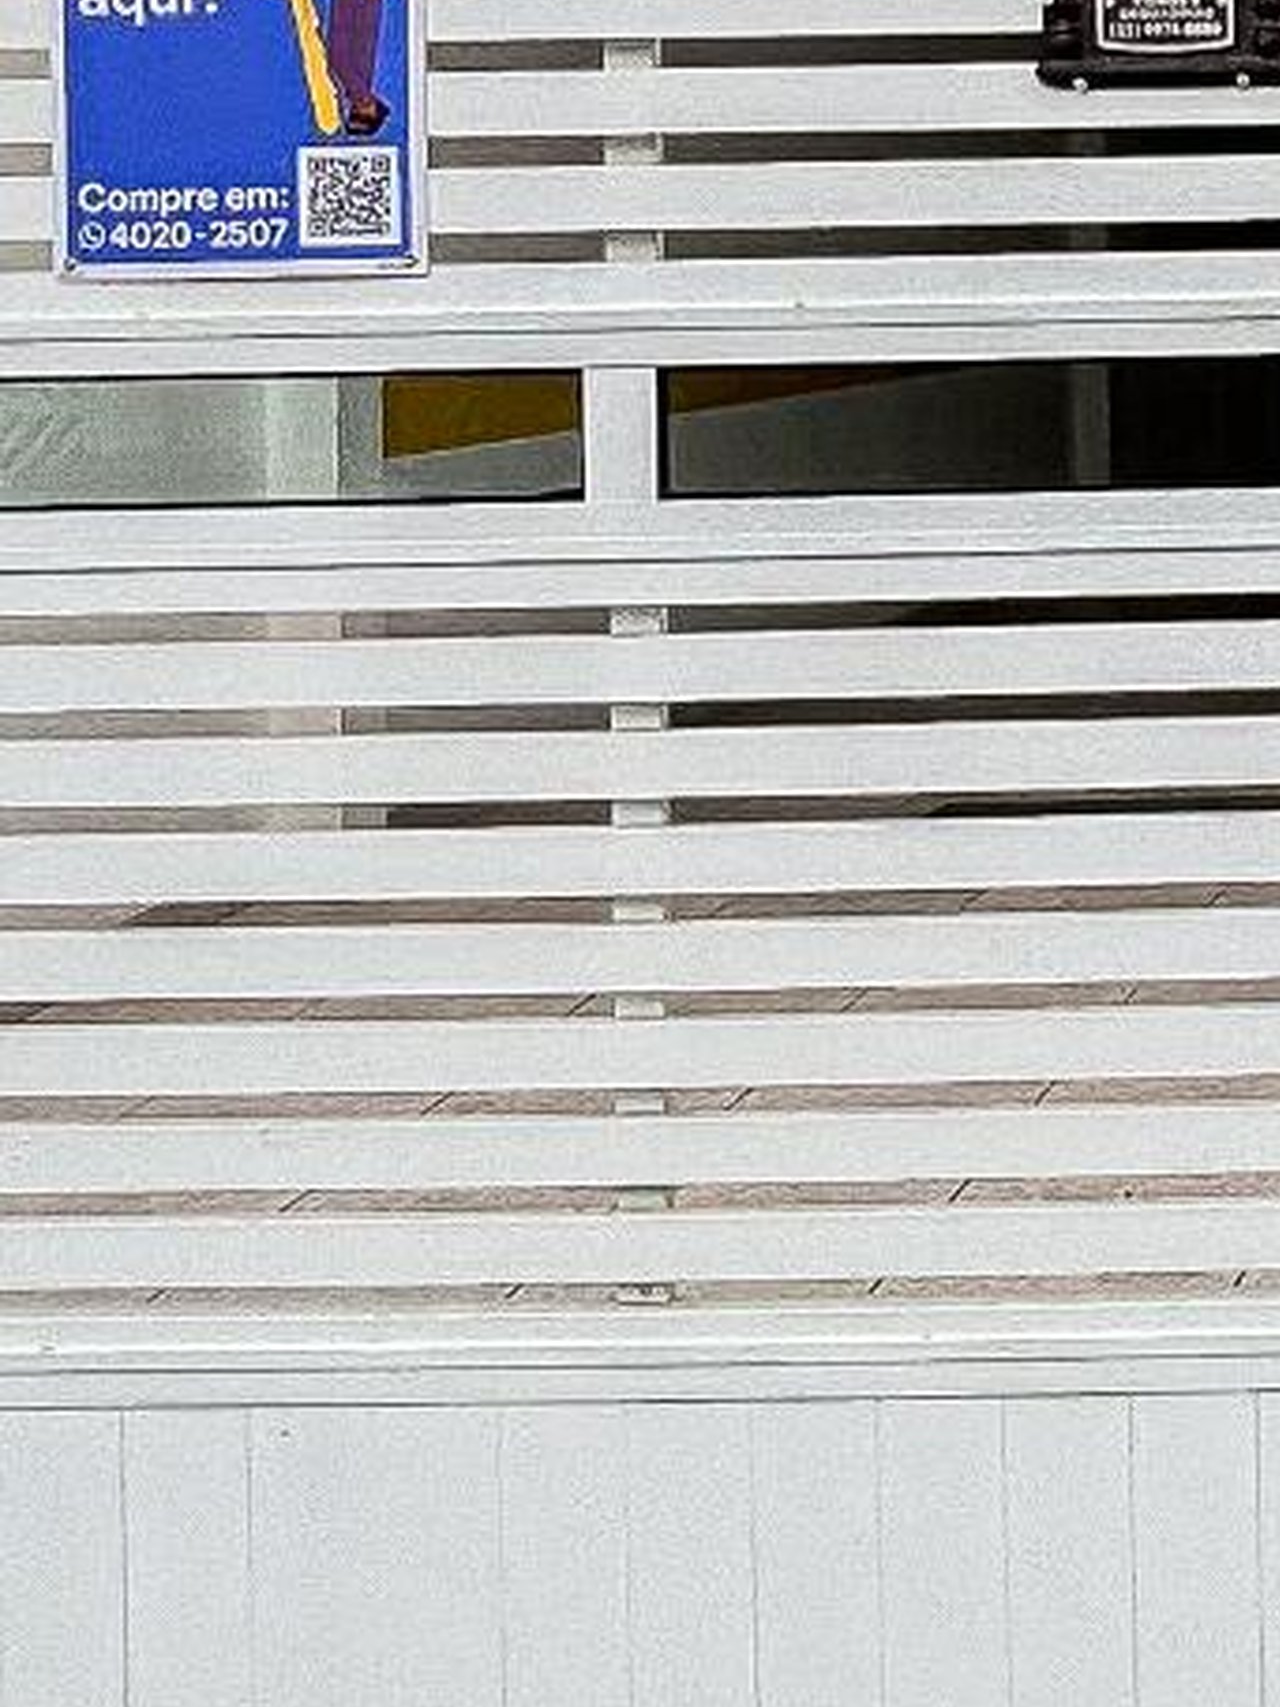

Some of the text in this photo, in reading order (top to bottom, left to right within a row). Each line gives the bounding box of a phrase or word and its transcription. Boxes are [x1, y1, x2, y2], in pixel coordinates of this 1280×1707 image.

[78, 183, 291, 218] Compre em:
[110, 218, 290, 249] 4020-2507
